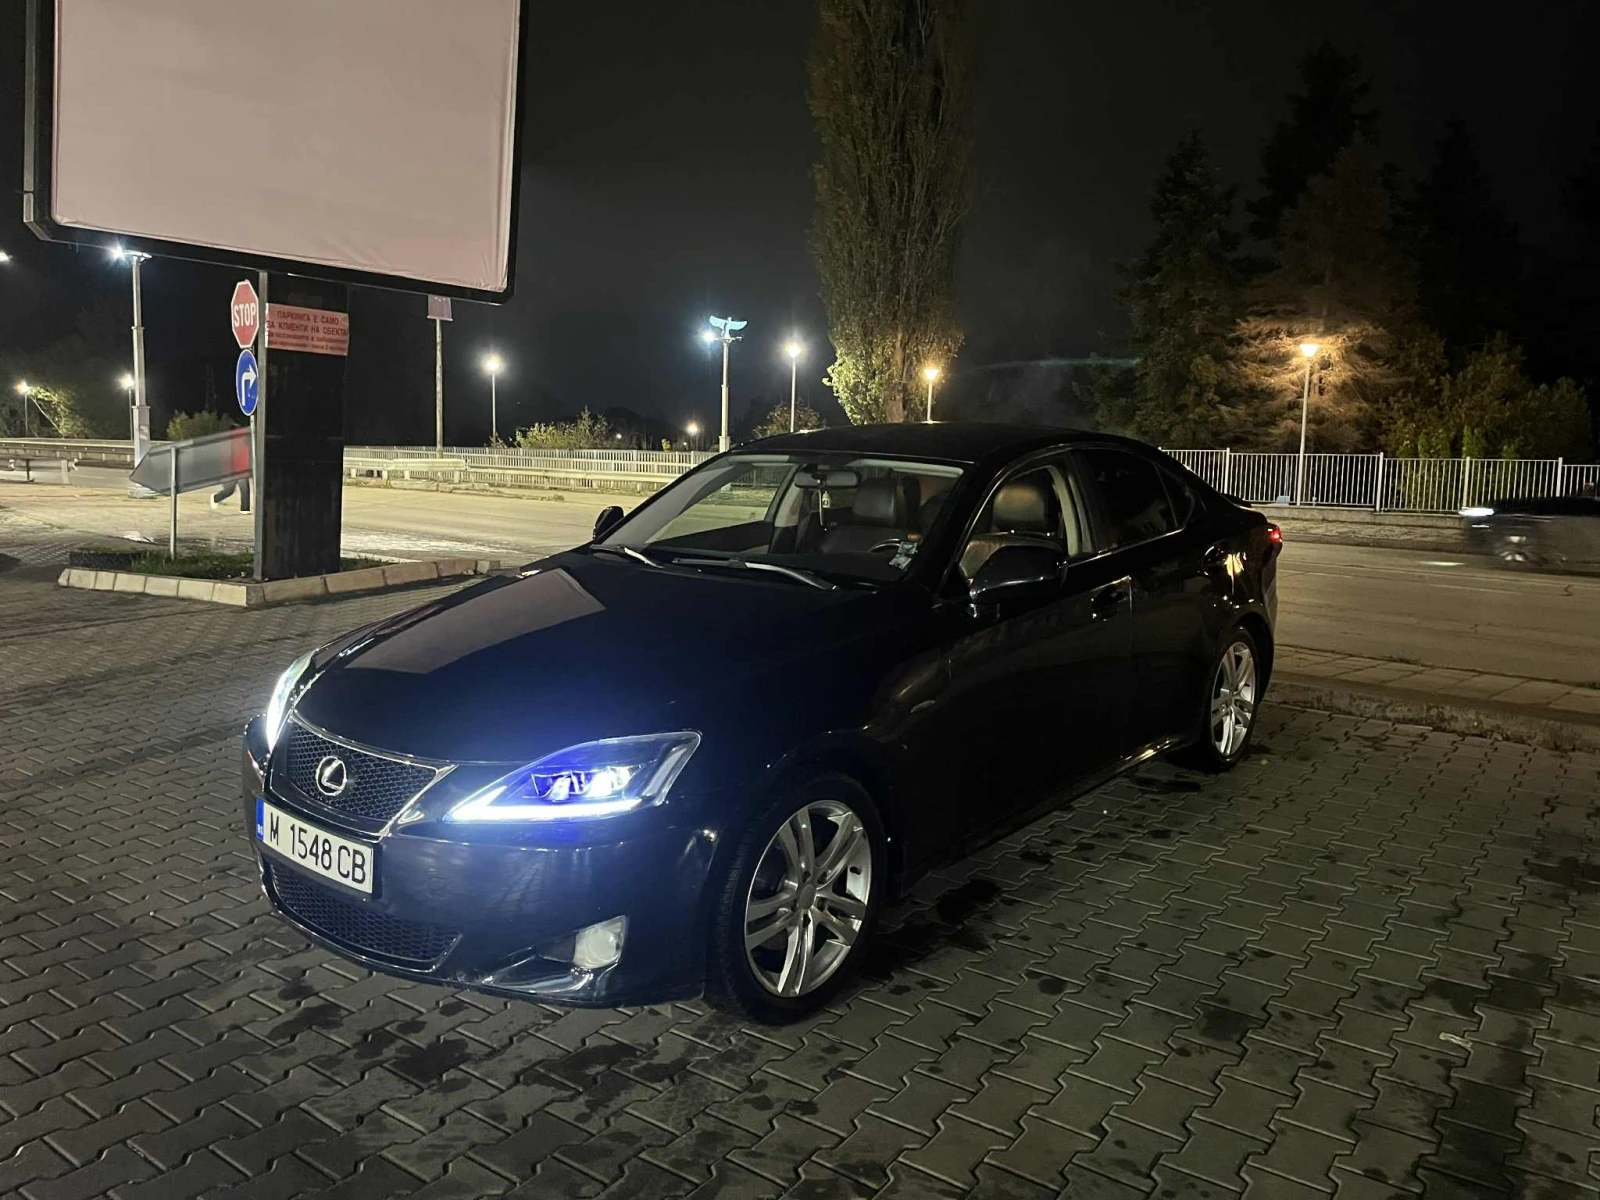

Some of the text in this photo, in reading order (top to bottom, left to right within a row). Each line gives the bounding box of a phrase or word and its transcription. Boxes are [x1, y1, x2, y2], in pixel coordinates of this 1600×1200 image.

[234, 303, 256, 327] STOP
[277, 311, 310, 322] ПАРКИНГА
[321, 316, 339, 325] САМО
[270, 812, 366, 884] M 1548 CB
